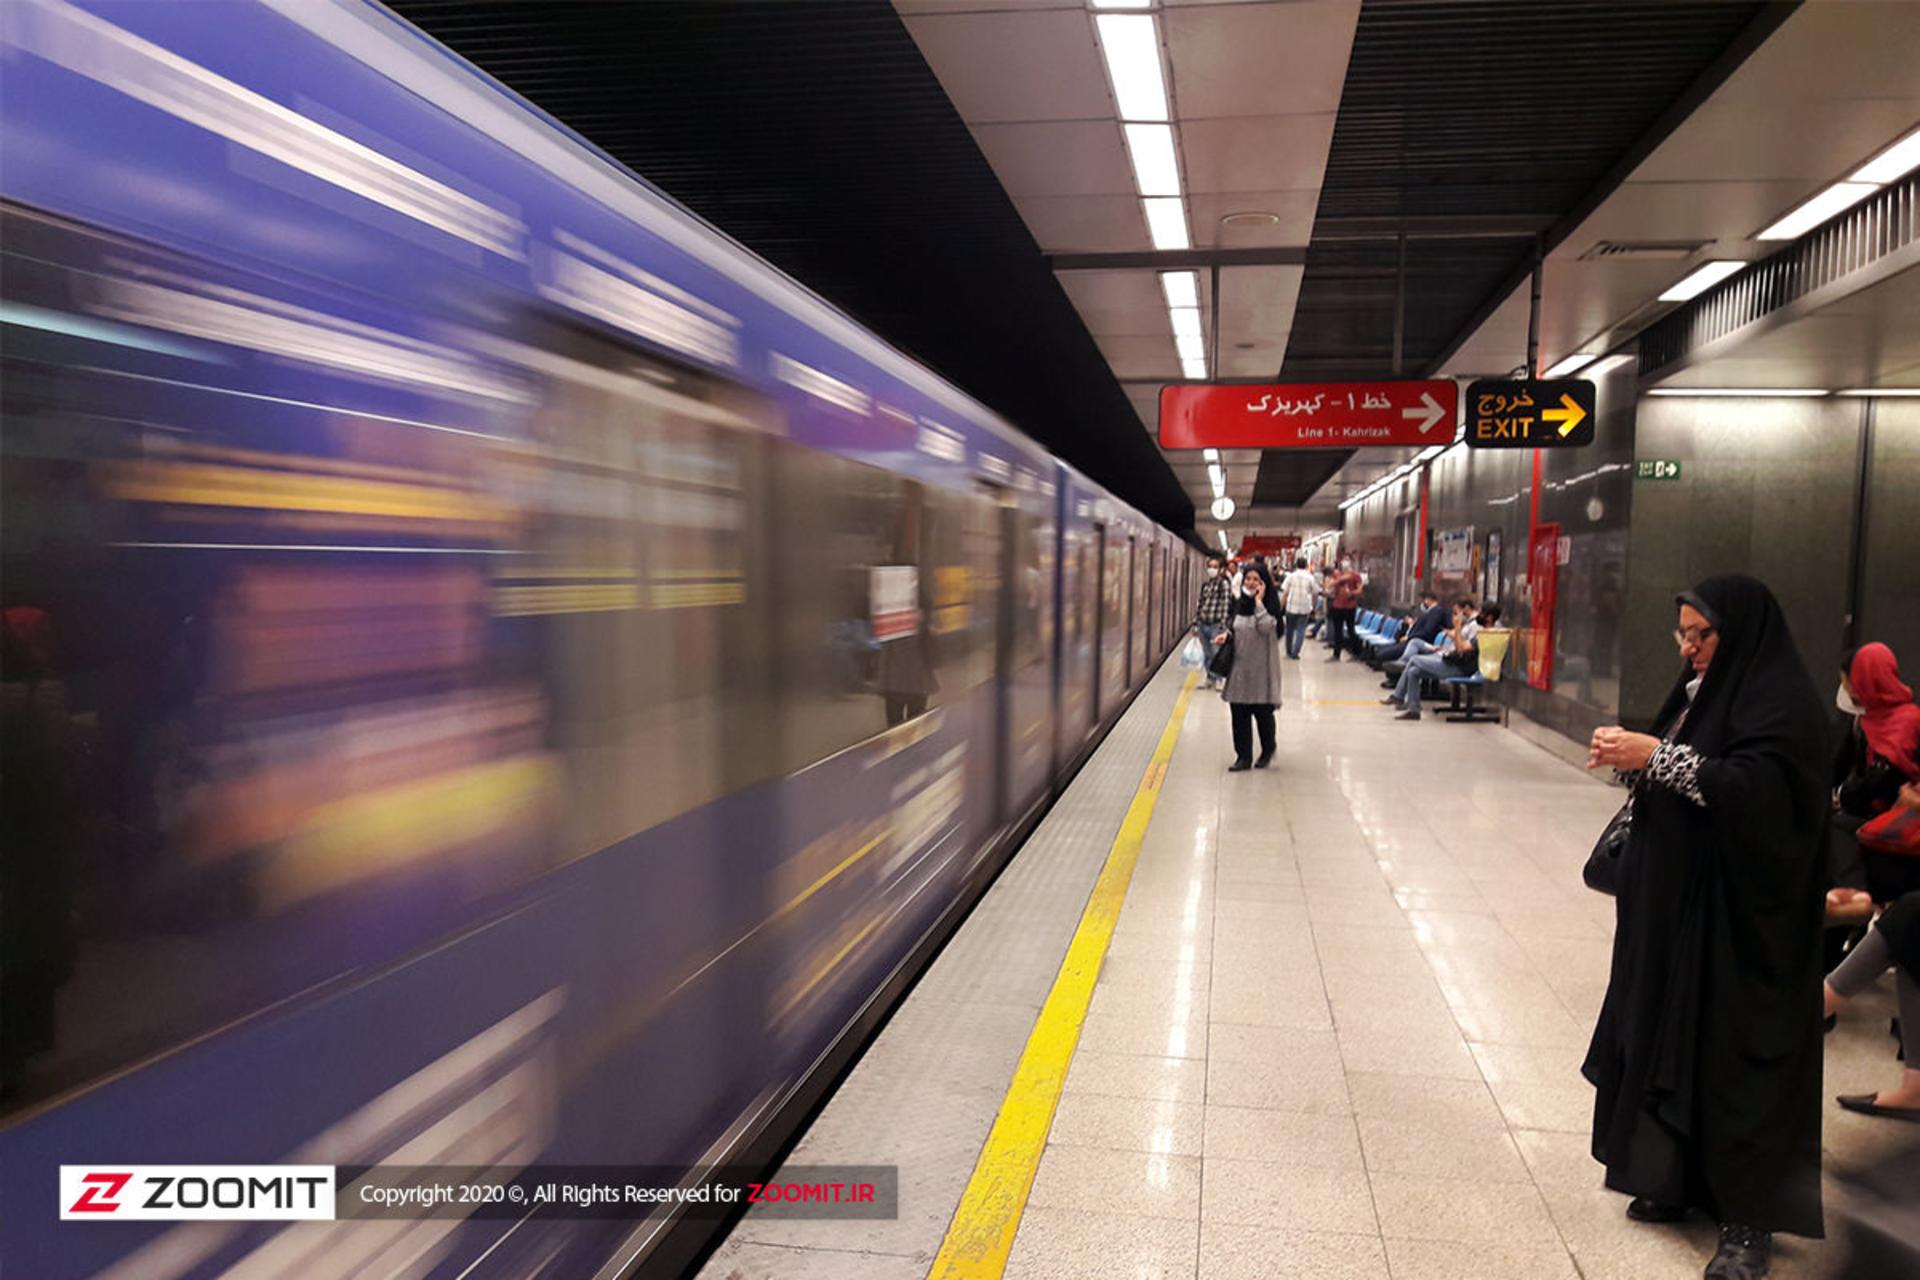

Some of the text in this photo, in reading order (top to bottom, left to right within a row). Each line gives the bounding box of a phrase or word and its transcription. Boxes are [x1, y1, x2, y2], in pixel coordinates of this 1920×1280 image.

[1246, 393, 1326, 416] کهریزک
[1361, 392, 1391, 409] خط
[1477, 389, 1534, 416] خروج
[1298, 427, 1323, 438] Line
[1343, 426, 1391, 437] Kahrizak
[1477, 417, 1534, 438] EXIT
